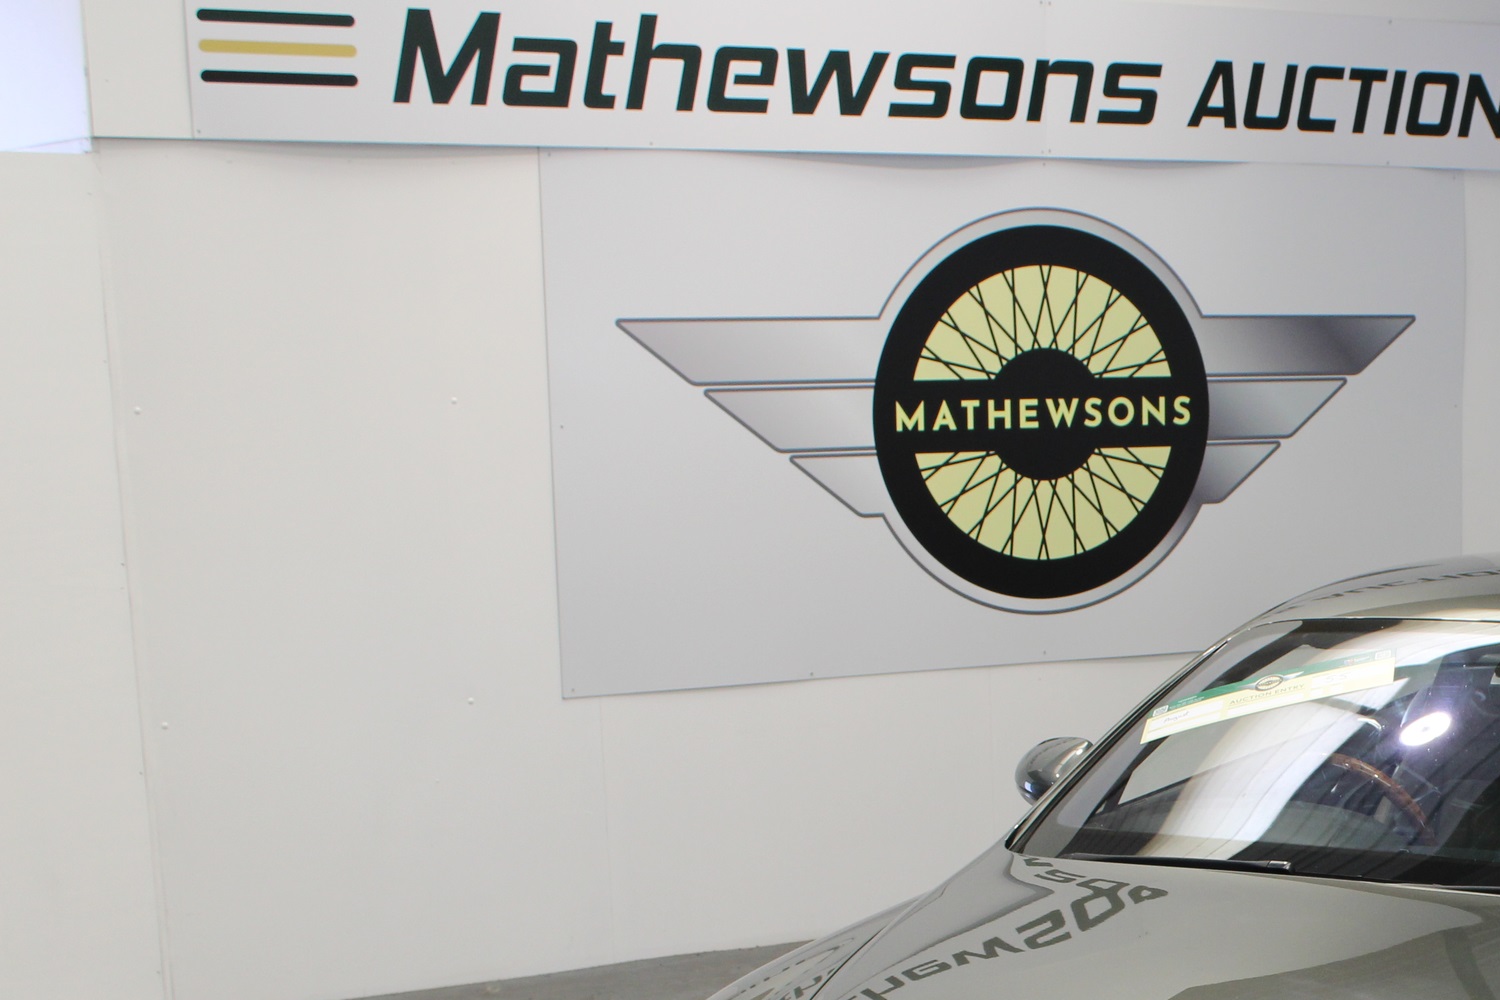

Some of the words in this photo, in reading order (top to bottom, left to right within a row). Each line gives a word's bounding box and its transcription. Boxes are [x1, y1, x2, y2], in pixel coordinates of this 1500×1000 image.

[393, 8, 1163, 125] Mathewsons
[895, 395, 1191, 432] MATHEWSONS
[1229, 691, 1272, 706] AUCTION
[1274, 683, 1305, 695] ENTRY
